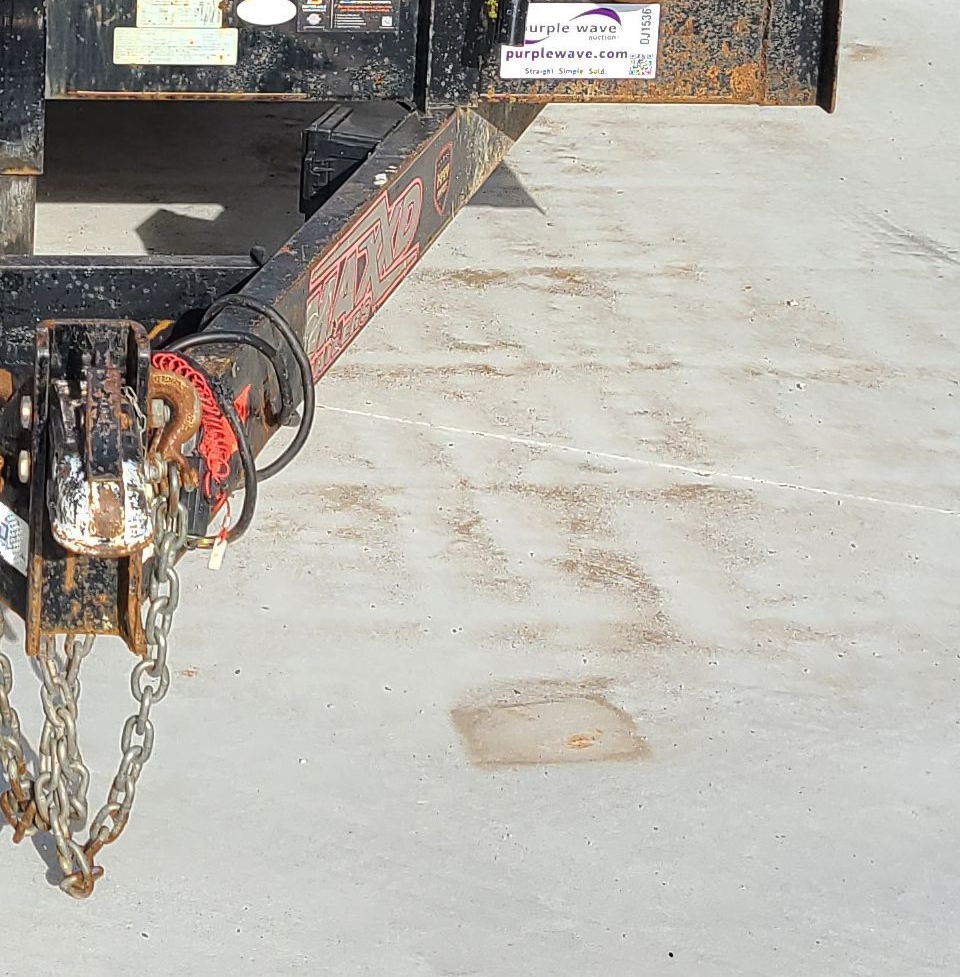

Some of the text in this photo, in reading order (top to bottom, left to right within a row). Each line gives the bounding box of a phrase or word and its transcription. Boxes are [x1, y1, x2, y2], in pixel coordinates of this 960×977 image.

[525, 22, 617, 35] urple wave
[505, 48, 628, 61] purplewave.com
